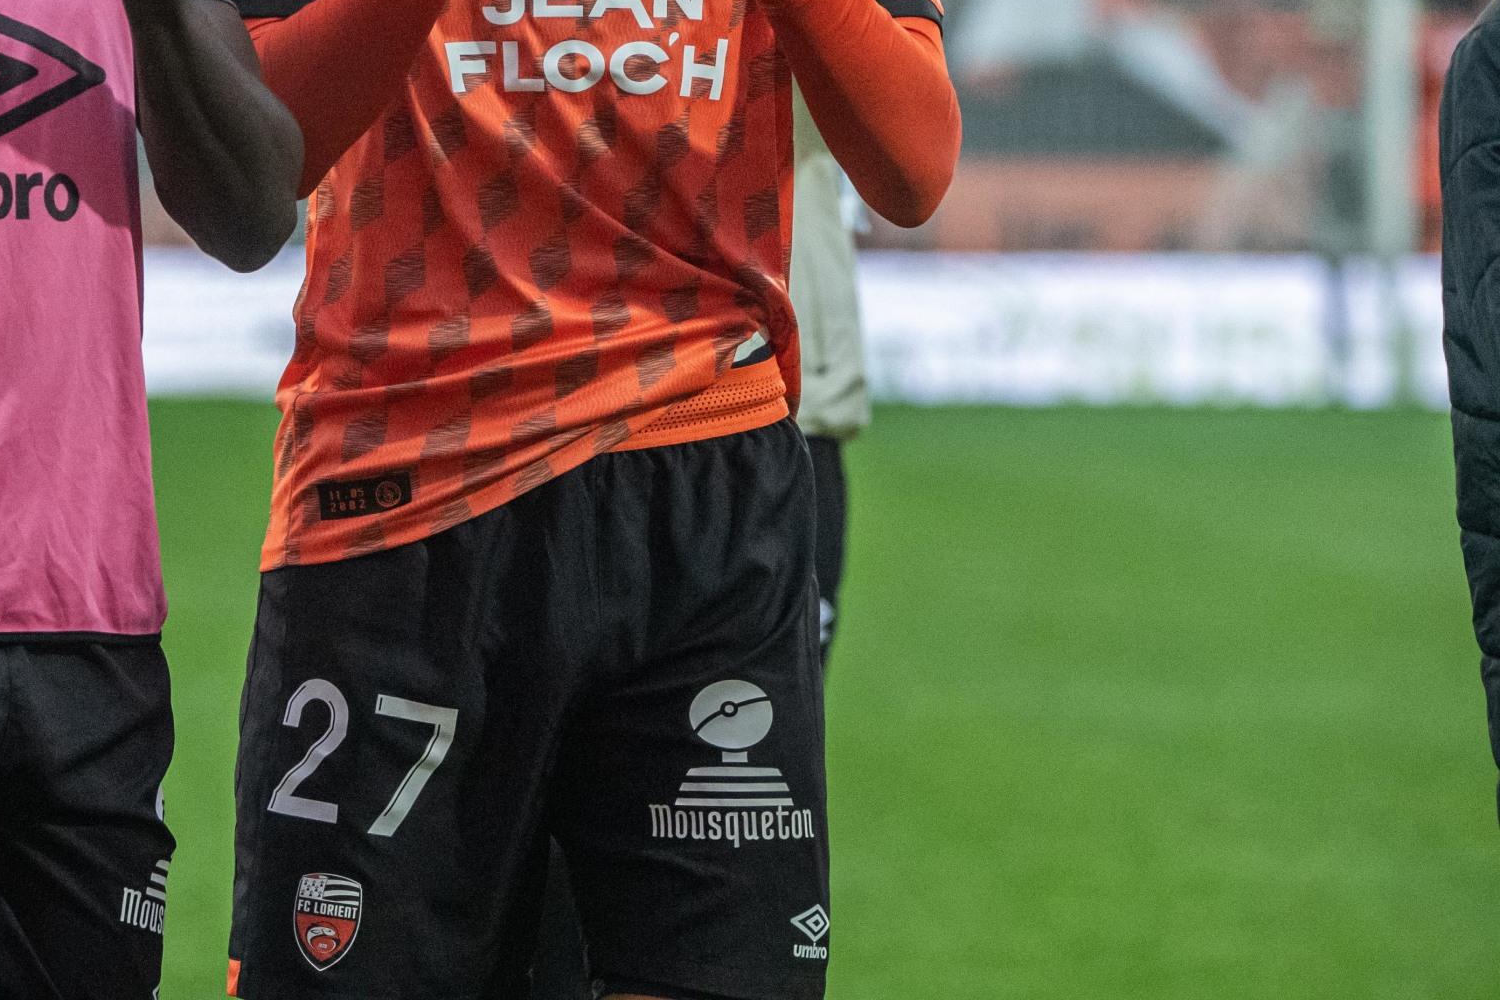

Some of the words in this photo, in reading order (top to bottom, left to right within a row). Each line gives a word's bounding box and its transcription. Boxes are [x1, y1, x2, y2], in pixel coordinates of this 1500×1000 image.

[443, 31, 729, 101] FLOC'H
[266, 678, 459, 838] 27
[297, 898, 311, 912] FC
[313, 901, 359, 920] LORIENT
[792, 942, 828, 960] umbro
